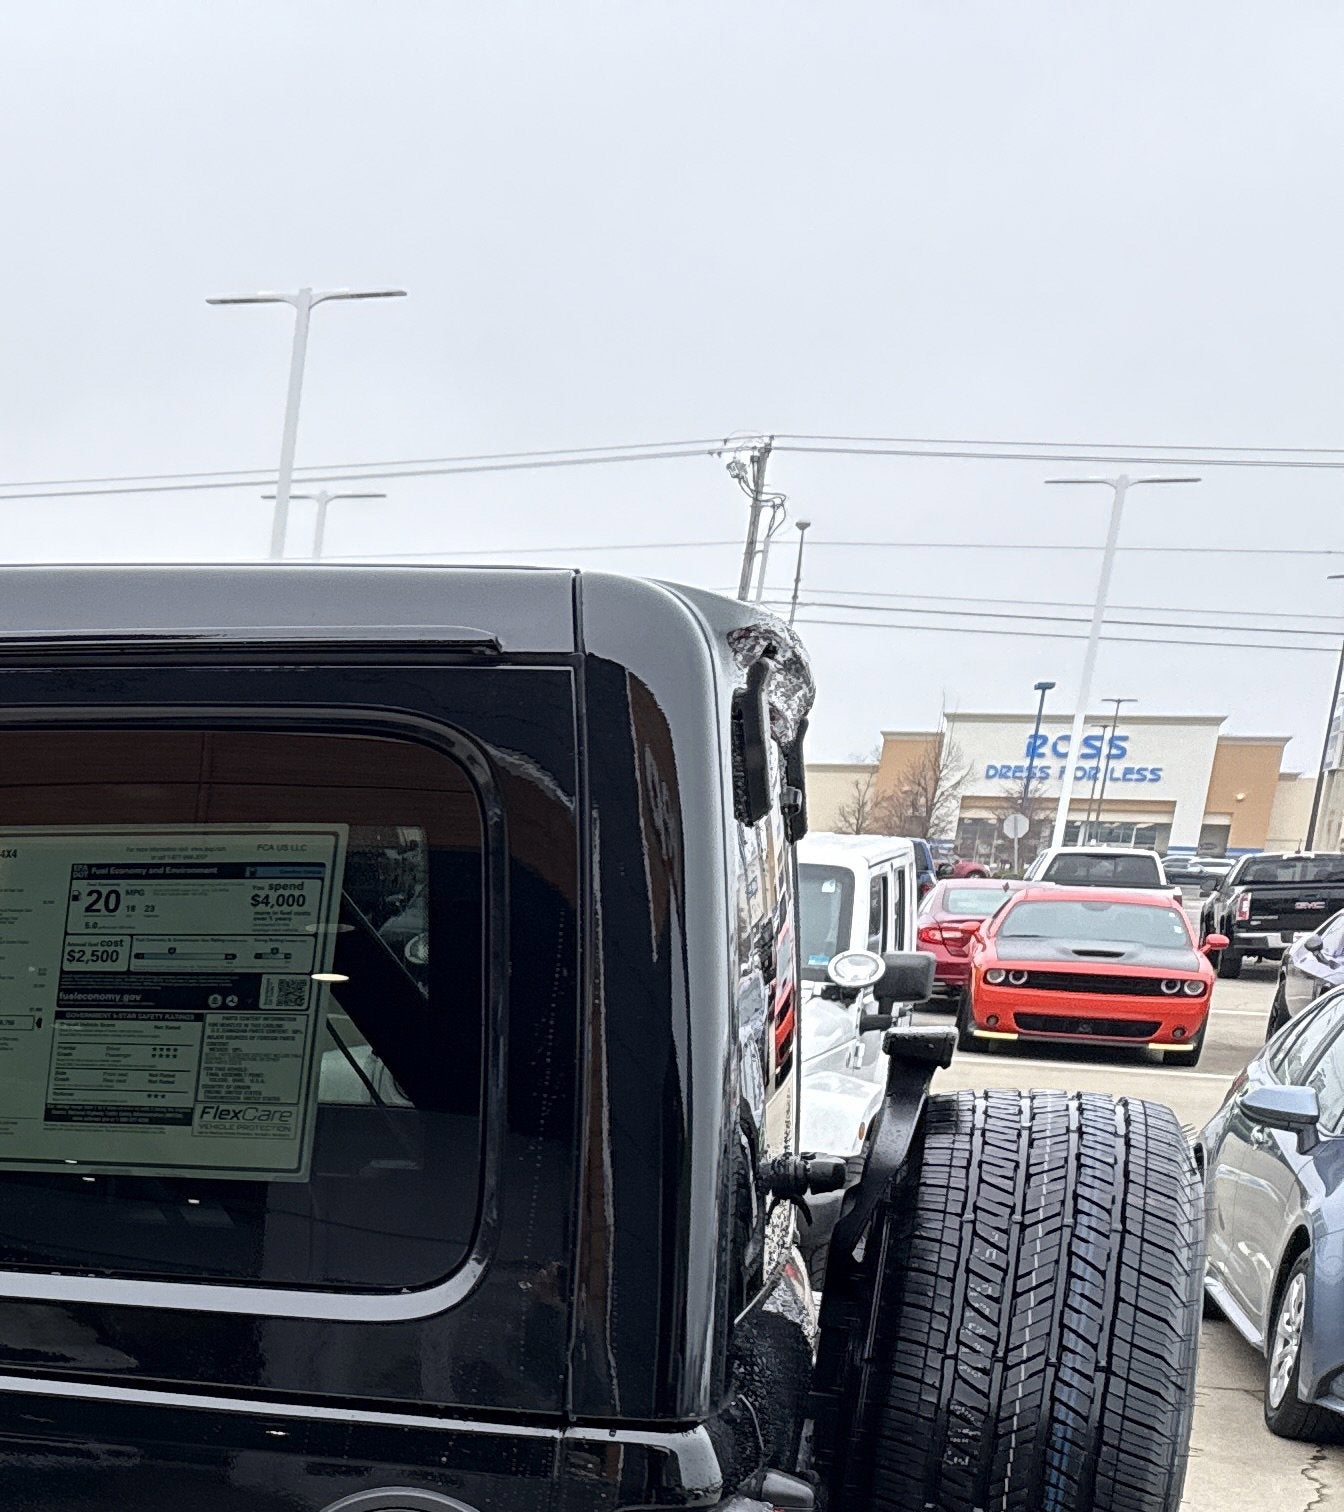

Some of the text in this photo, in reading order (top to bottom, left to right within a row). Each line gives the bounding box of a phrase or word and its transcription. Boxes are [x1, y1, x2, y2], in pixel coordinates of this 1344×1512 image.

[1025, 734, 1130, 760] ROSS
[985, 765, 1052, 781] DRESS
[1109, 767, 1163, 783] LESS
[0, 848, 18, 859] 4X4
[257, 844, 274, 852] FCA
[267, 881, 305, 893] spend
[84, 889, 121, 913] 20
[250, 893, 306, 909] $4,000
[100, 939, 124, 947] cost
[66, 949, 119, 965] $2,500
[200, 1105, 293, 1122] FlexCare
